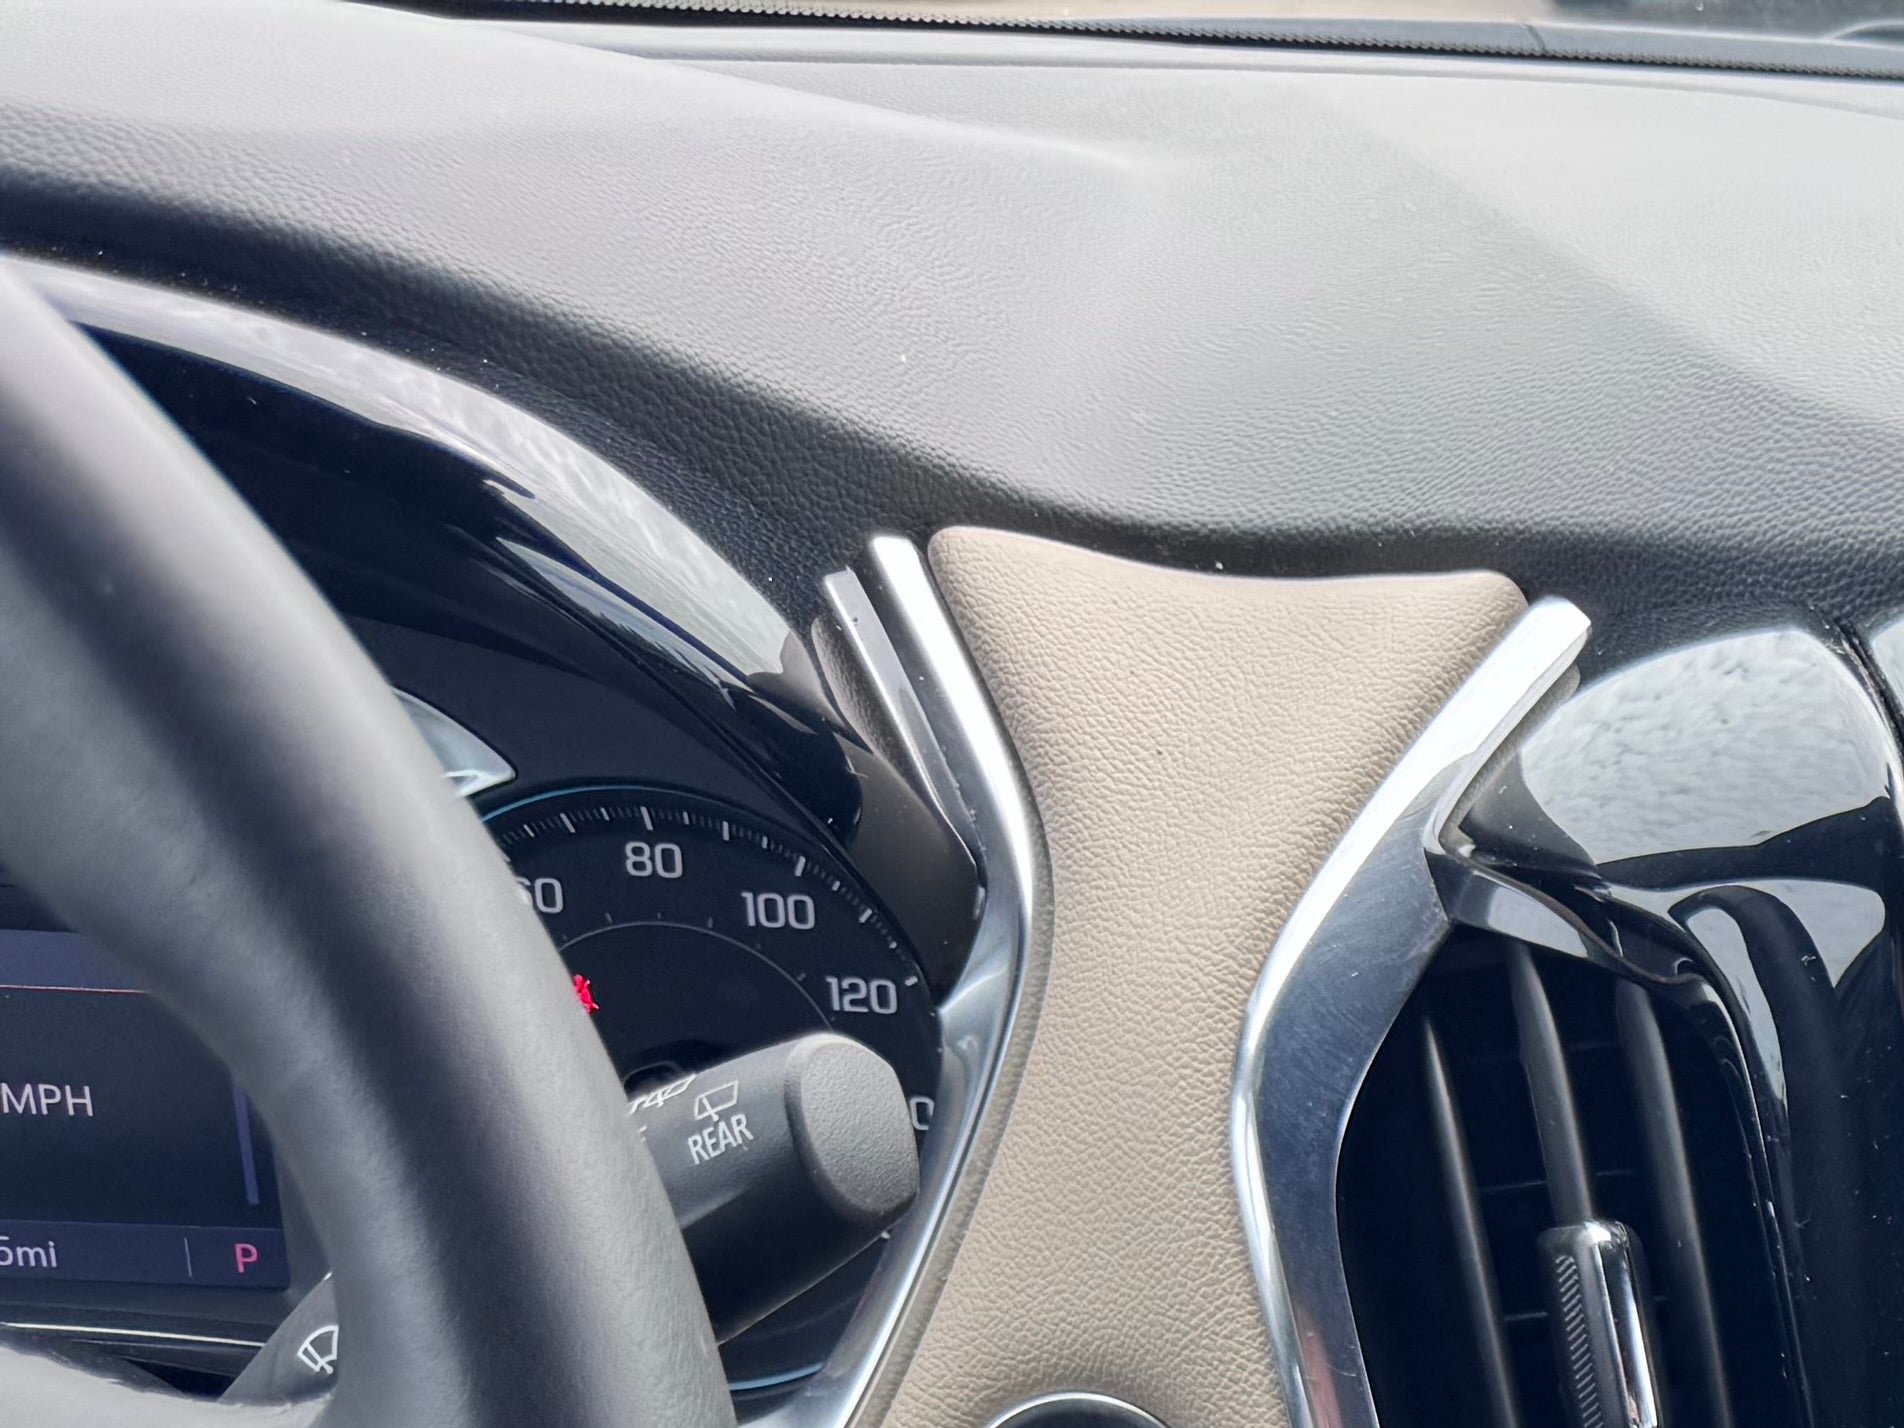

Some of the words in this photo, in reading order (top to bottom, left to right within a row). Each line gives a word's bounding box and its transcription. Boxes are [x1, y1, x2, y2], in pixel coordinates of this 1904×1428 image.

[625, 841, 683, 879] 80
[741, 892, 815, 930] 100
[826, 976, 897, 1014] 120
[0, 1082, 94, 1117] MPH
[687, 1113, 754, 1165] REAR
[234, 1243, 258, 1273] P
